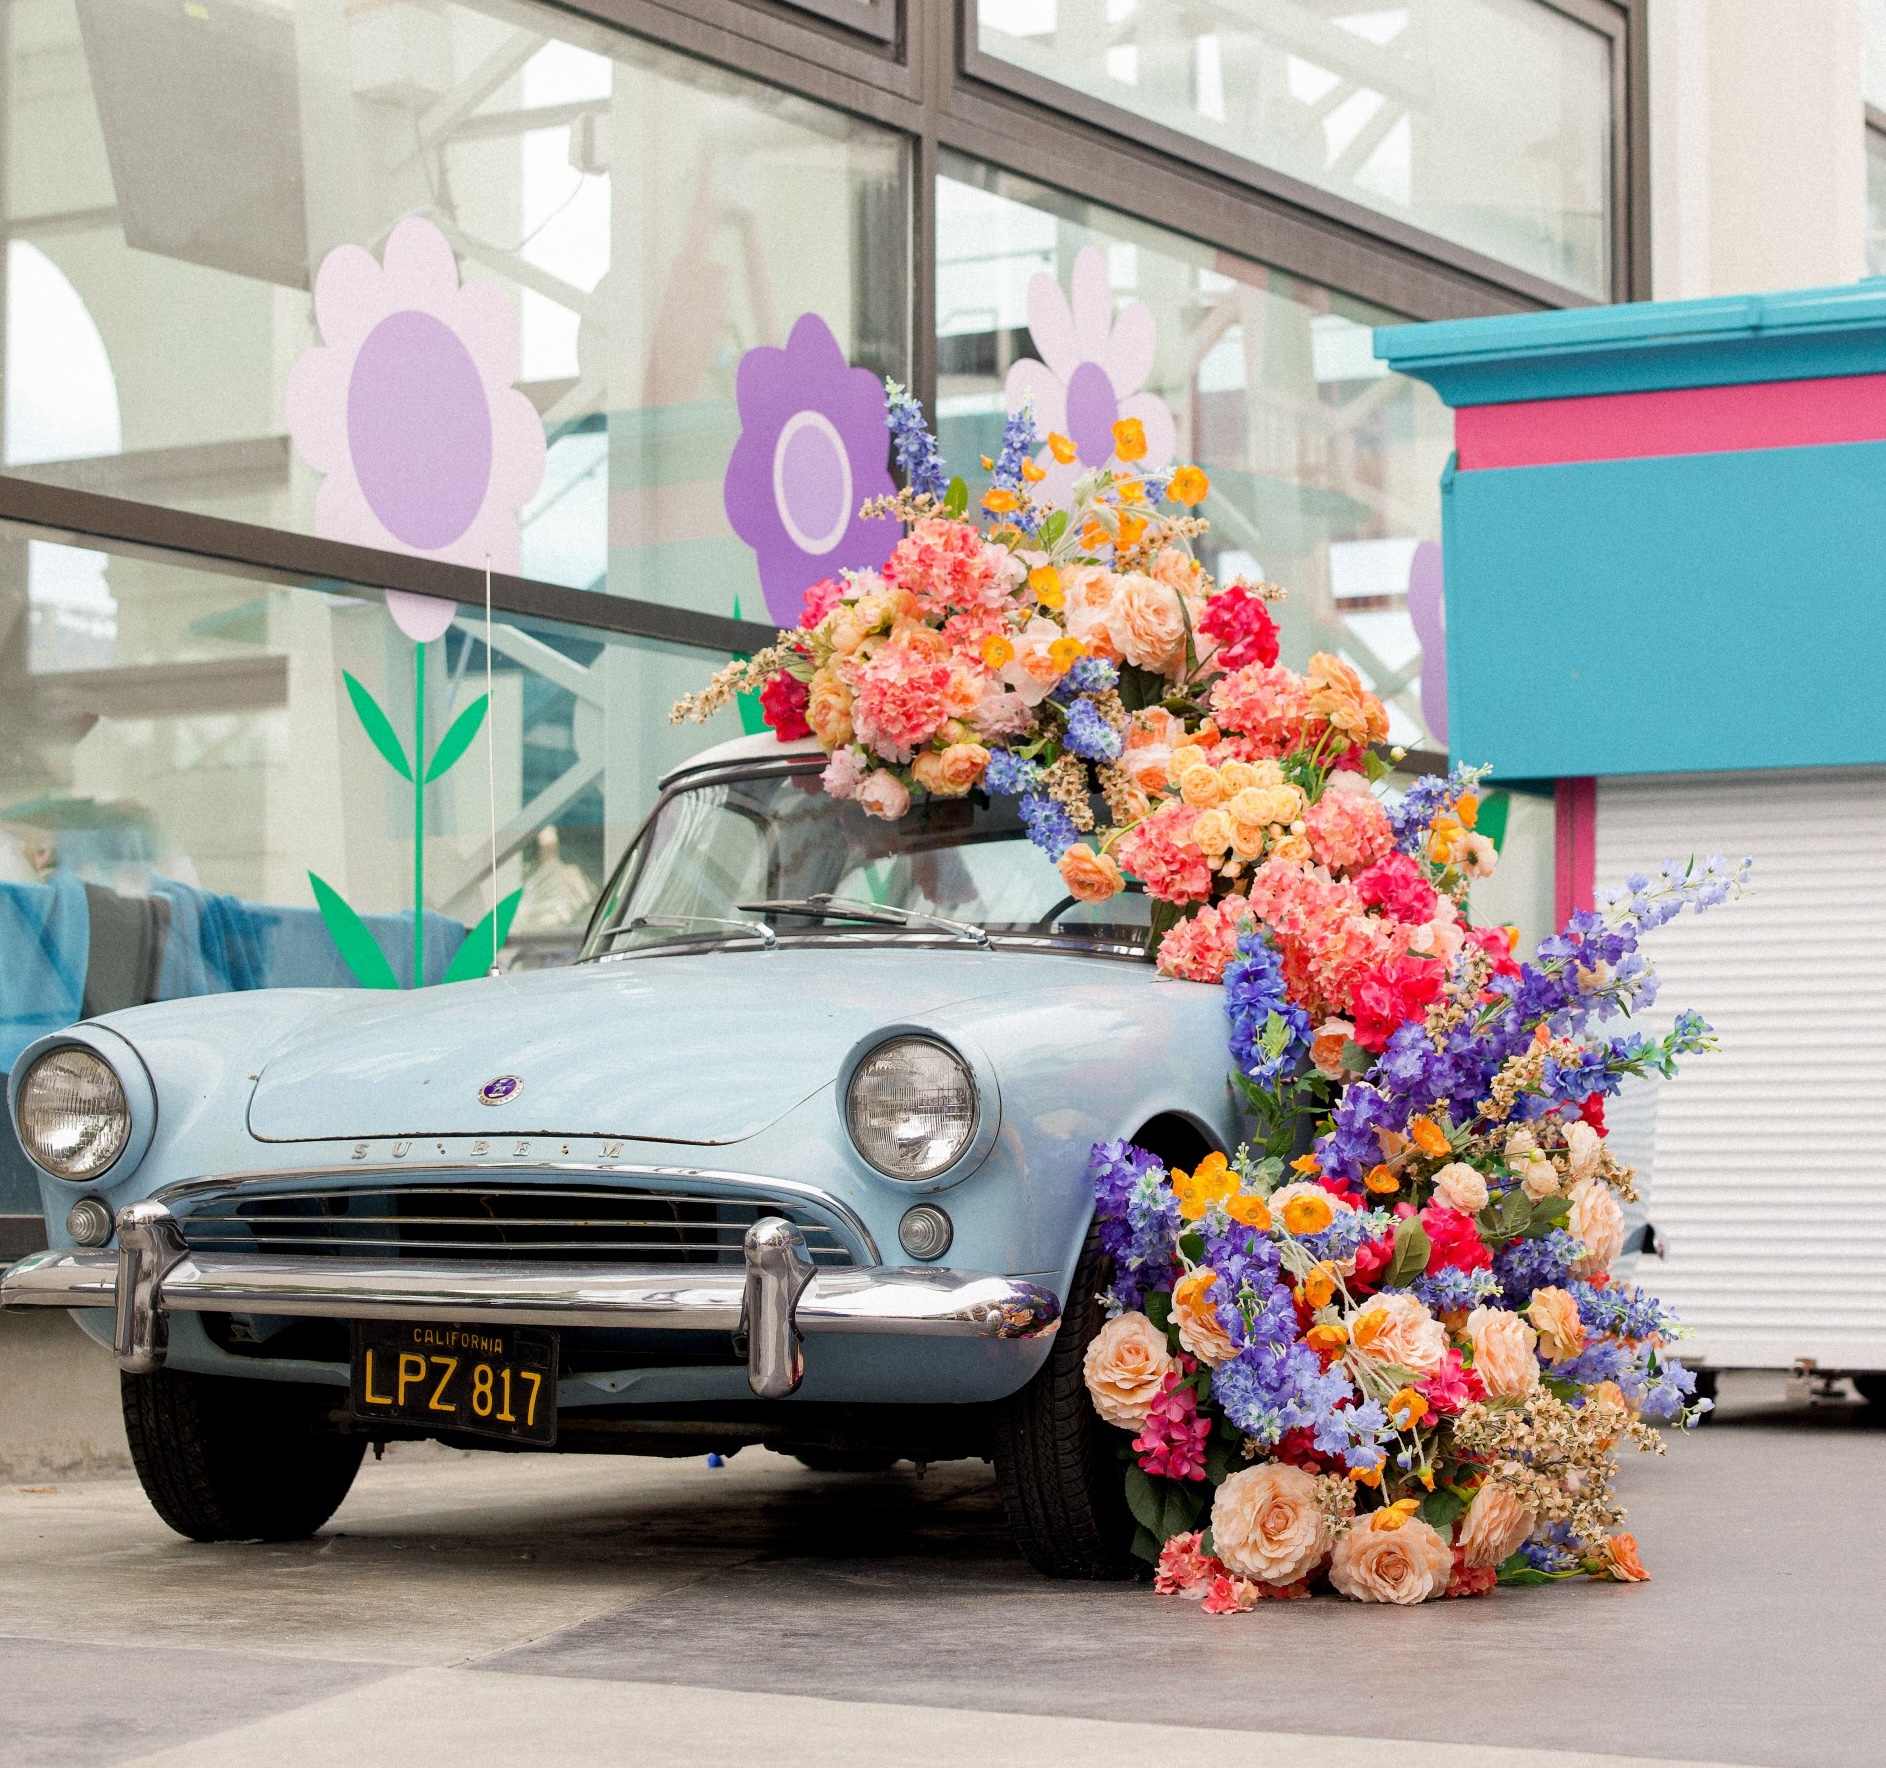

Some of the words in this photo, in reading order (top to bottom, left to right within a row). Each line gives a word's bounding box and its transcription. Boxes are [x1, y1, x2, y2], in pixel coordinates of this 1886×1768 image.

[351, 1140, 625, 1160] SUBEM
[413, 1328, 503, 1354] CALIFORNIA
[365, 1349, 458, 1412] LPZ
[472, 1364, 542, 1426] 817
